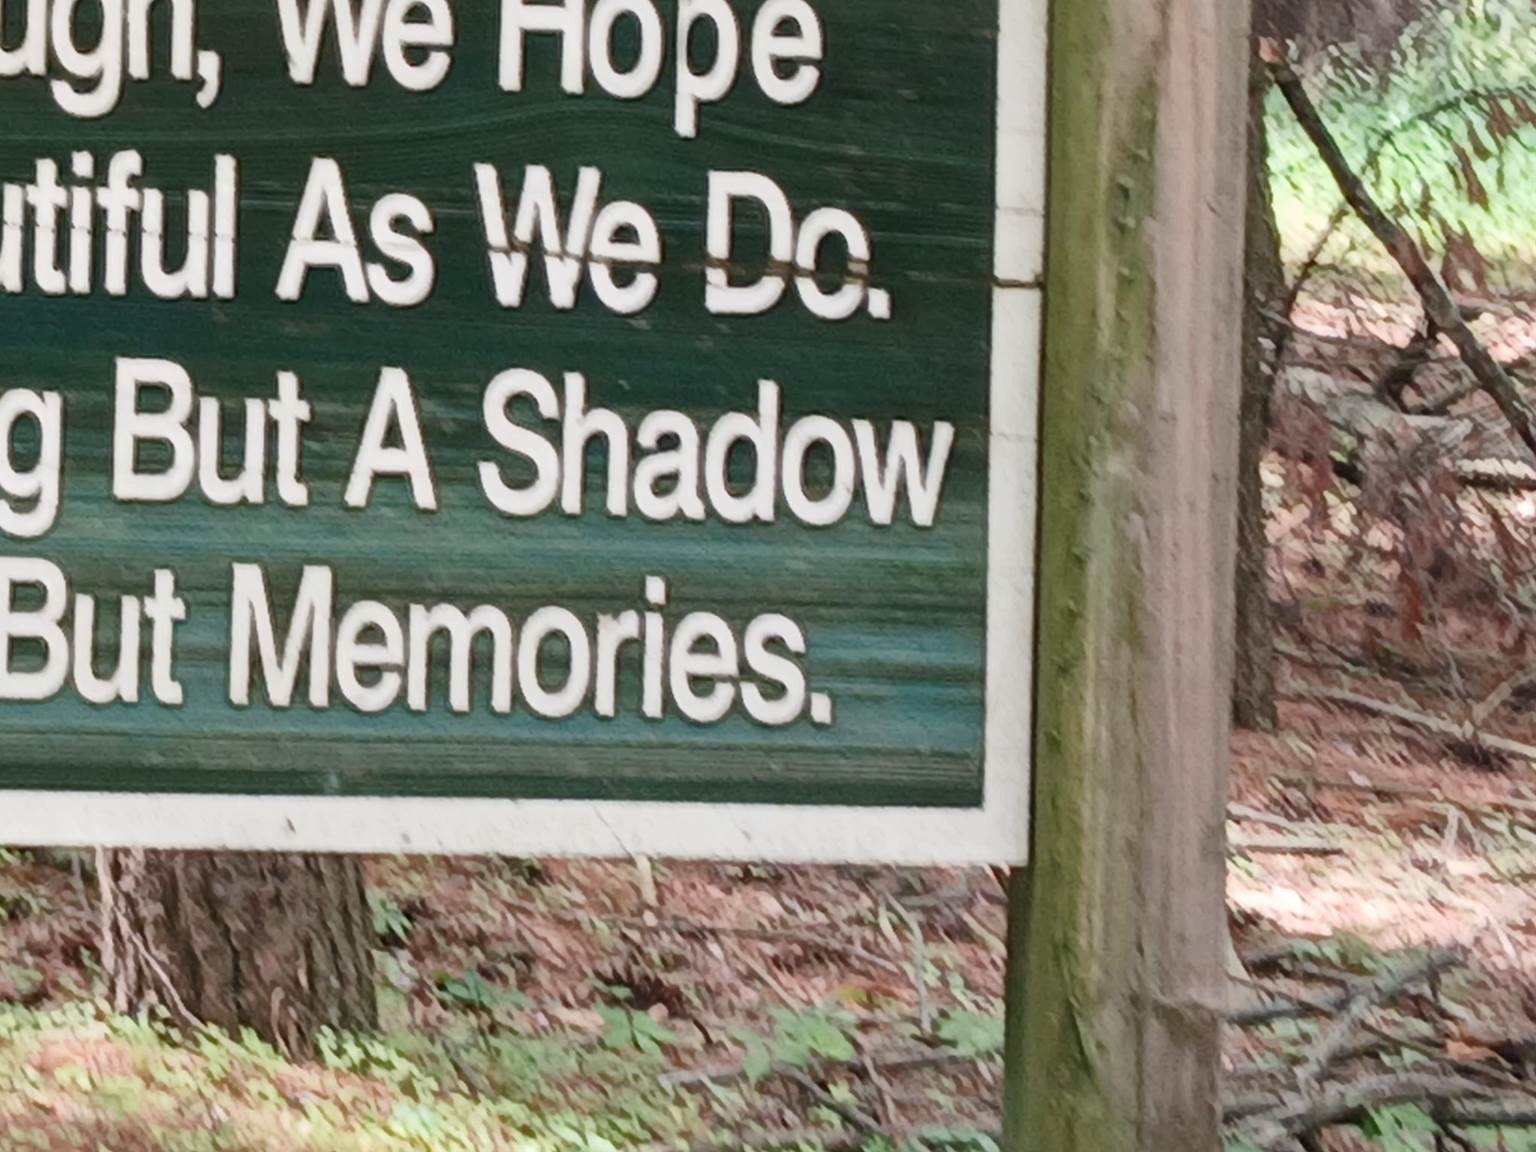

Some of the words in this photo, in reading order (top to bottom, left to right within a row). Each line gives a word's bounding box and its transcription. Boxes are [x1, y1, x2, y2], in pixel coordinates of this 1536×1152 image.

[274, 157, 434, 306] As
[473, 162, 661, 314] We
[704, 169, 890, 320] Do.
[112, 356, 311, 507] But
[343, 365, 438, 511] A
[477, 367, 955, 527] Shadow
[228, 561, 832, 725] Memories.
